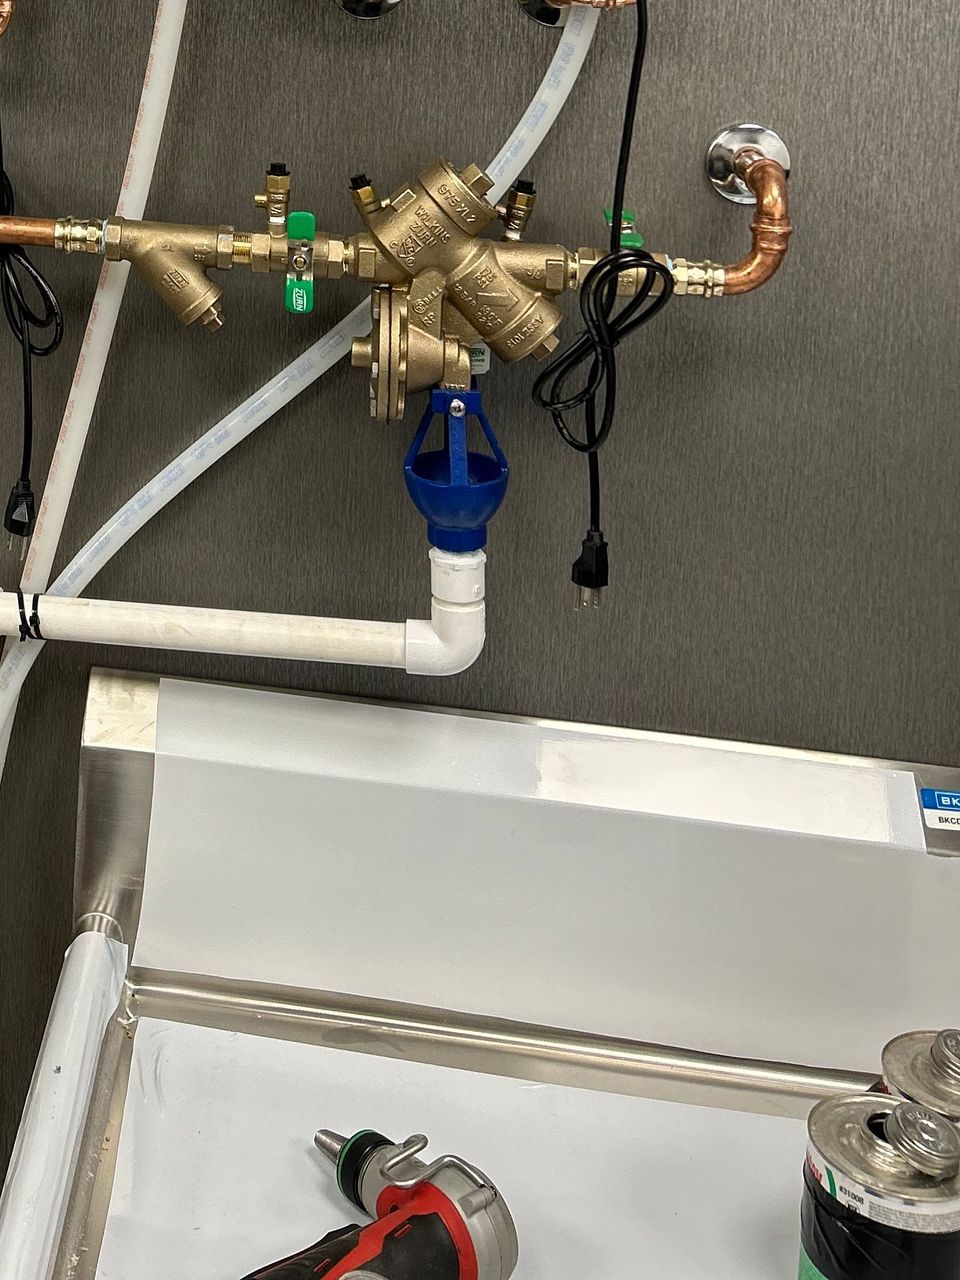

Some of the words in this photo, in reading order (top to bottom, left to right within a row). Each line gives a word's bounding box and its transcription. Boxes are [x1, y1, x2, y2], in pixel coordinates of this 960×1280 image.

[409, 220, 438, 248] ZURN
[414, 205, 451, 244] WILKINS
[295, 288, 304, 311] ZURN
[522, 314, 544, 336] ASSE
